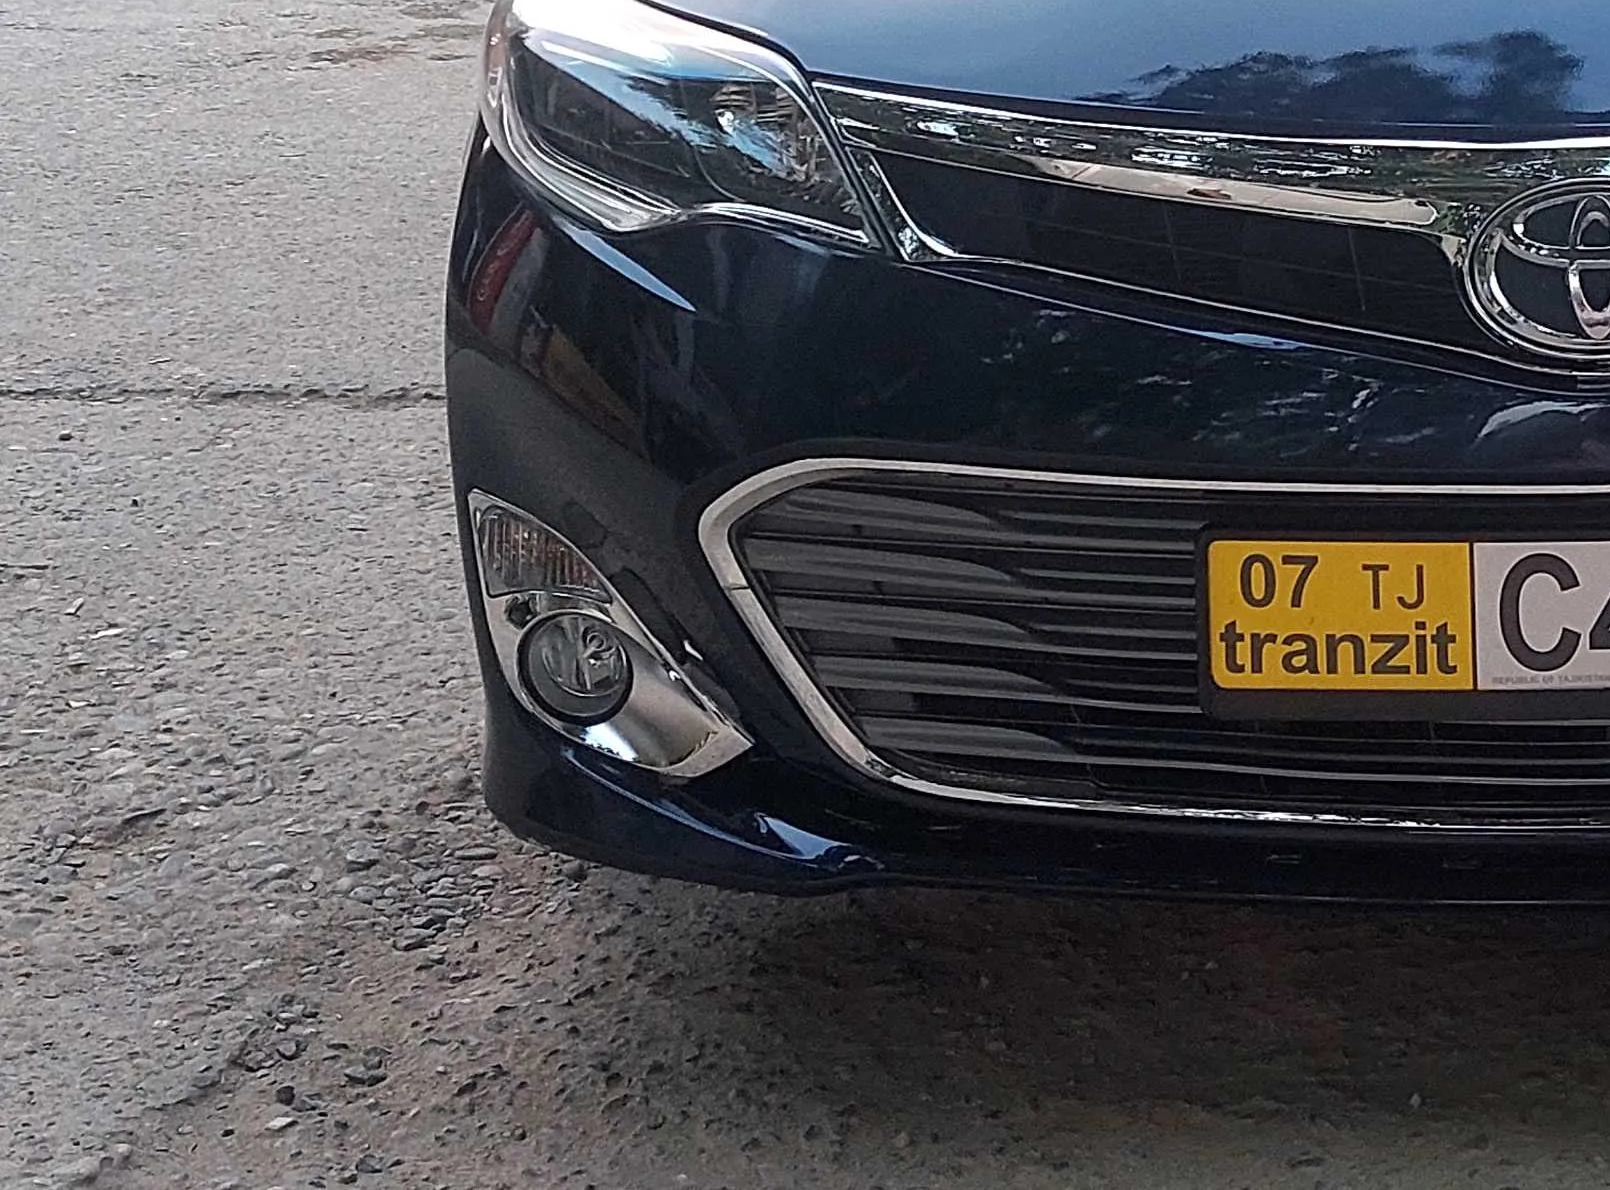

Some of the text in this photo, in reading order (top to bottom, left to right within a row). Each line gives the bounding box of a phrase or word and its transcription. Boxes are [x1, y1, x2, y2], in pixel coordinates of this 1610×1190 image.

[1238, 553, 1427, 610] 07 TJ
[1218, 620, 1458, 675] tranzit
